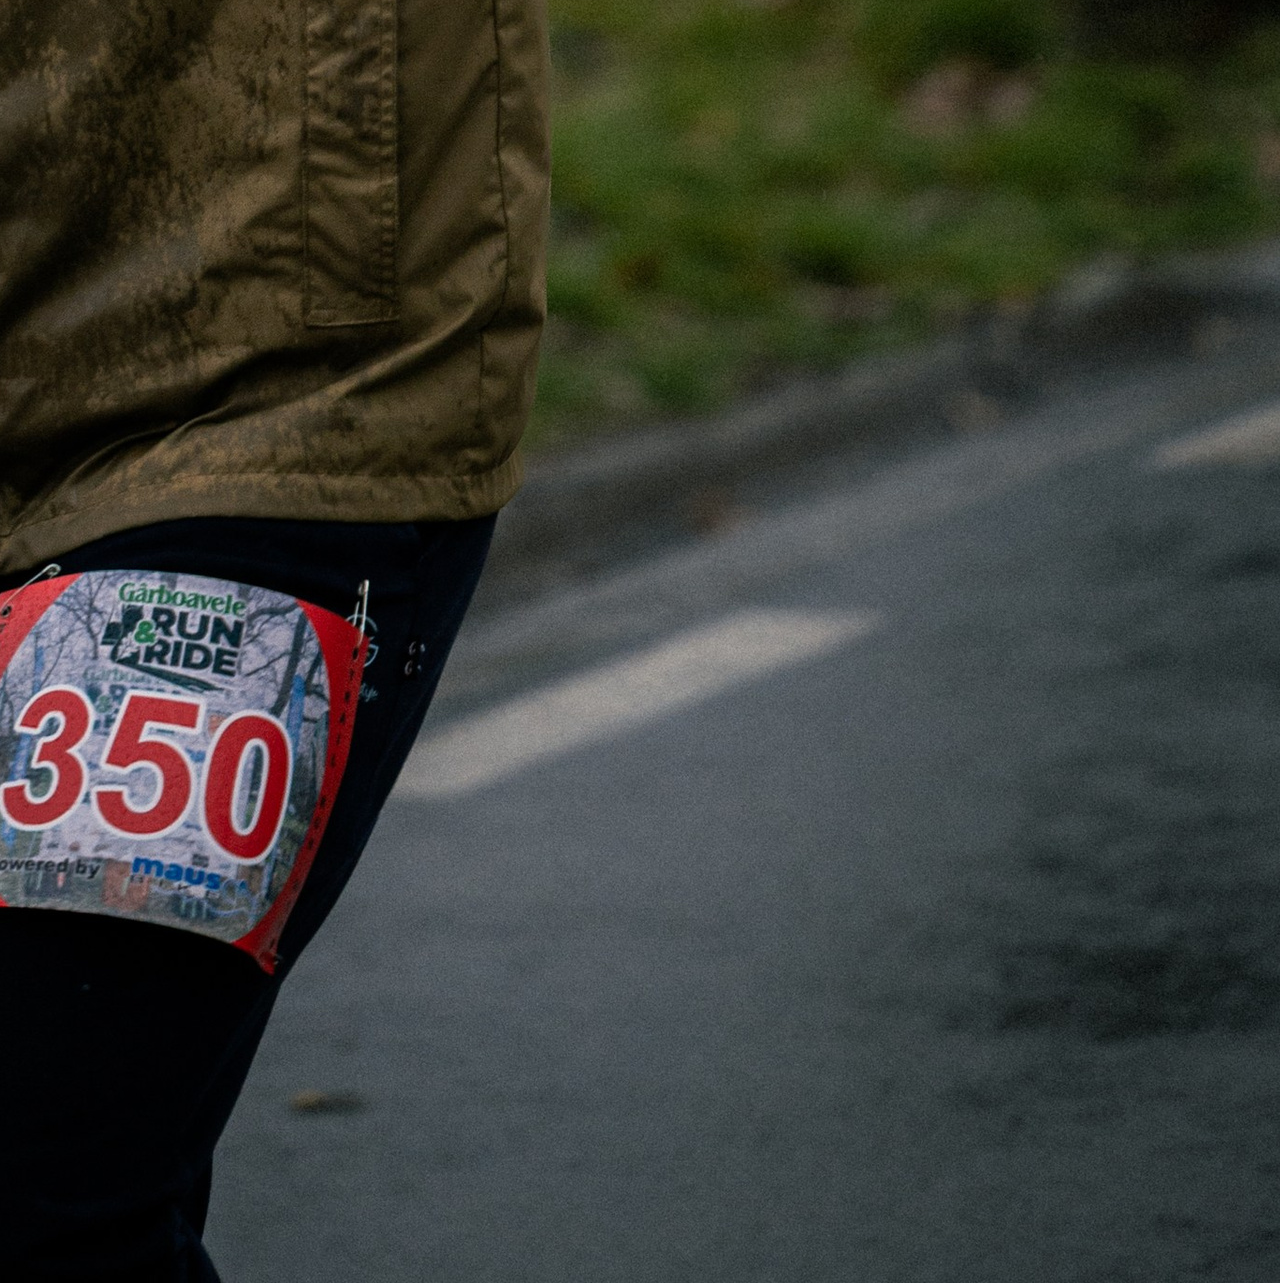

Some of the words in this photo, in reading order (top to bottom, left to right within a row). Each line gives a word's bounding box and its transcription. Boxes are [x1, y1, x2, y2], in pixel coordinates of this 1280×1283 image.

[151, 607, 245, 648] RUN
[143, 638, 239, 677] RIDE
[0, 686, 291, 863] 350
[75, 858, 102, 880] by
[131, 856, 222, 891] maus
